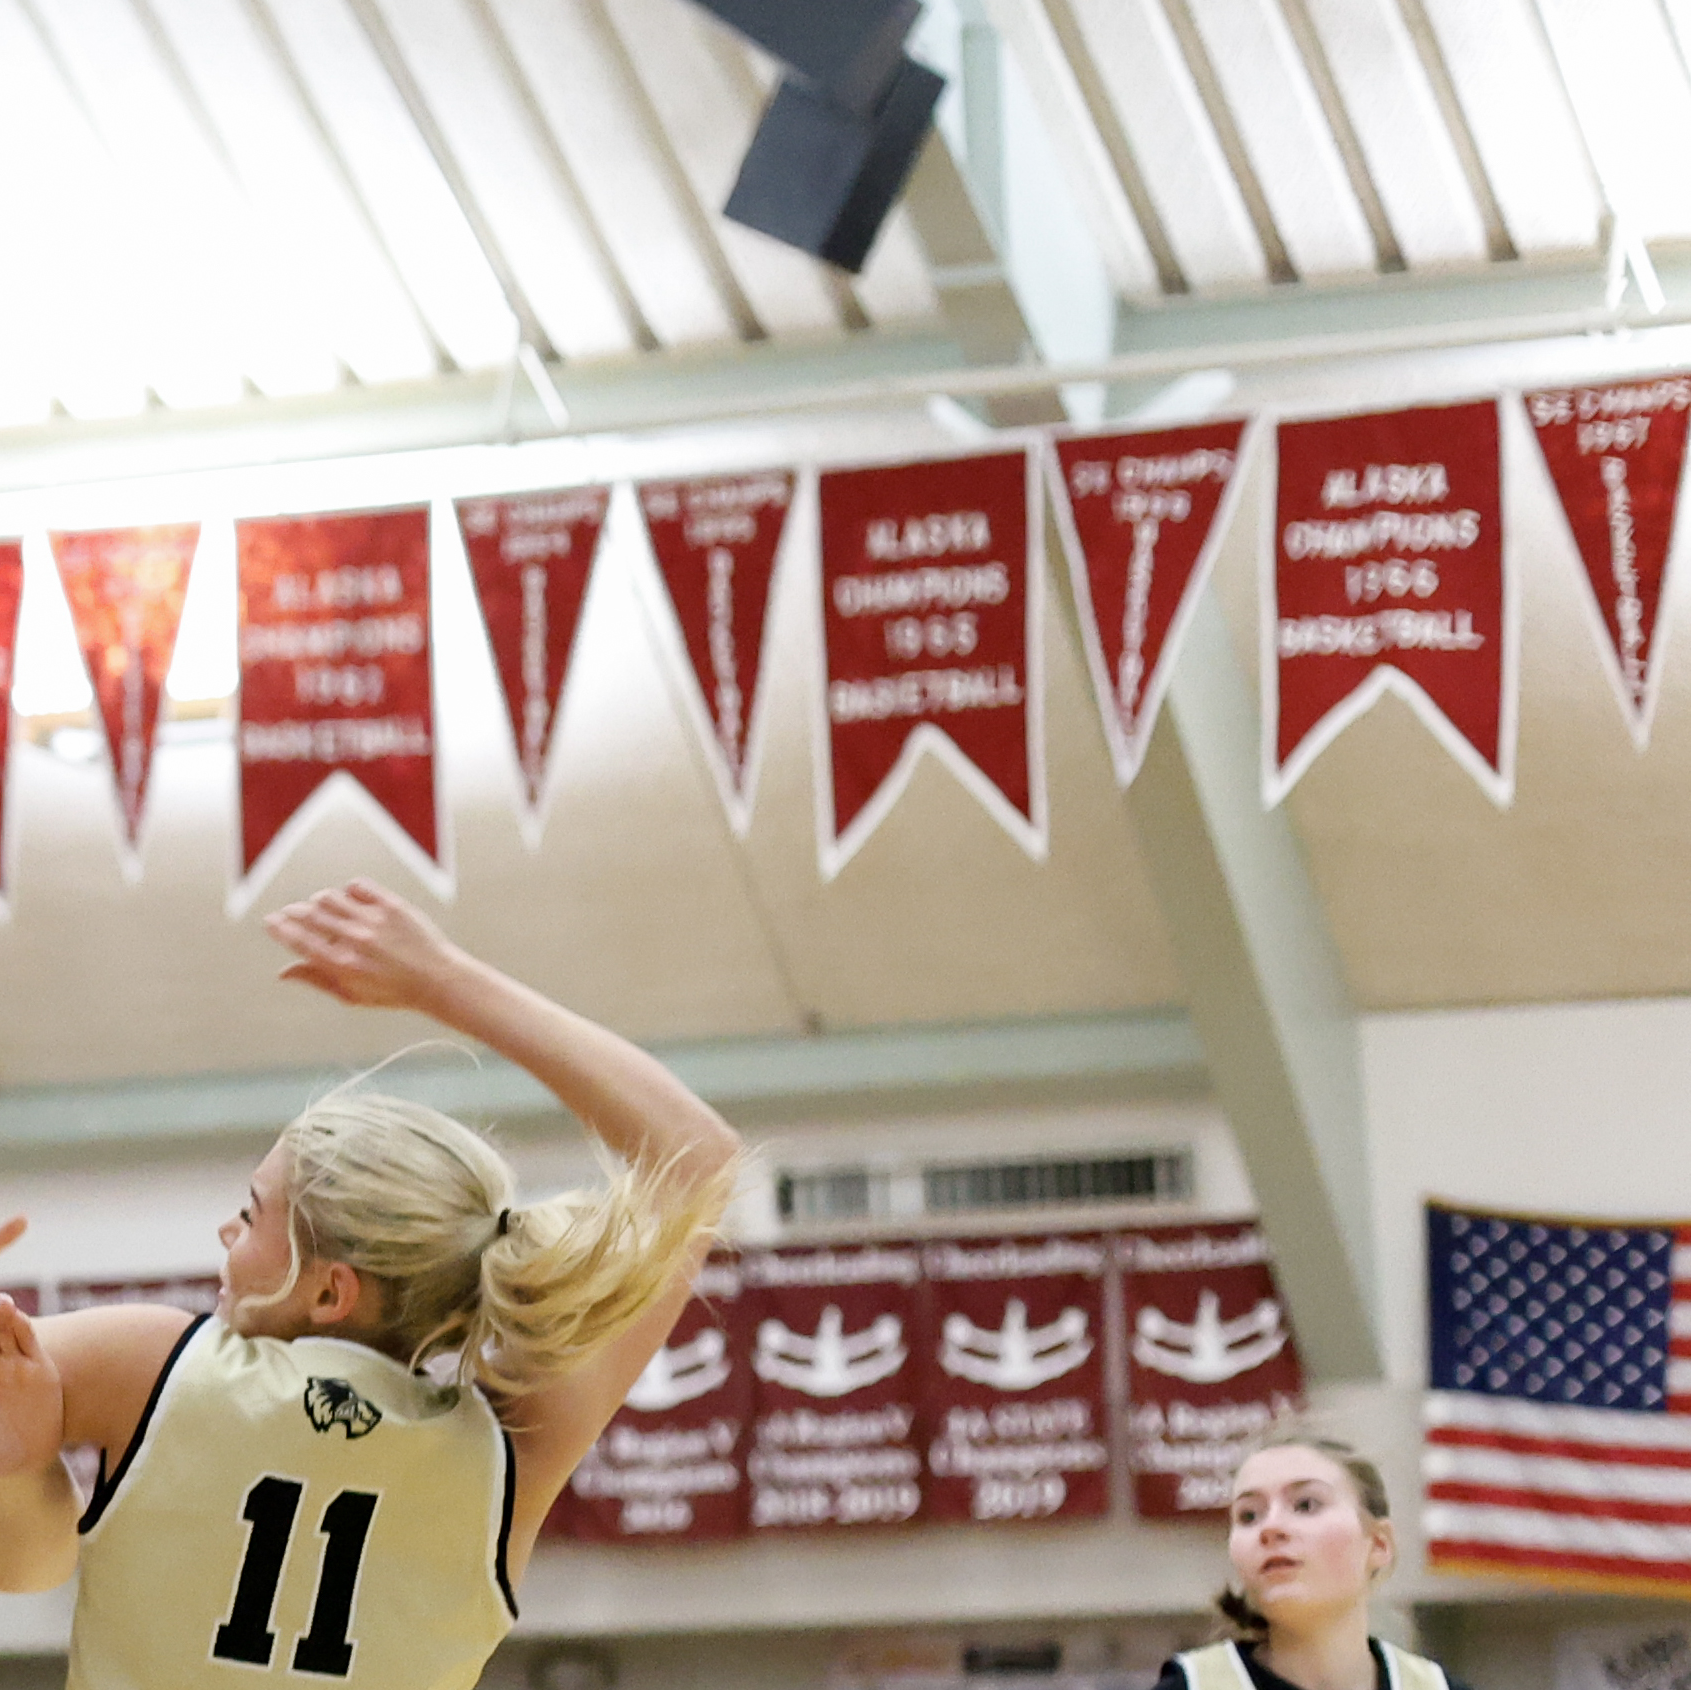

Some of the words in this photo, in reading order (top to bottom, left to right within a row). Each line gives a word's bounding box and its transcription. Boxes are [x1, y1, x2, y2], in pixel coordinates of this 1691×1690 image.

[1321, 463, 1450, 511] ALASKA
[865, 510, 992, 562] ALASKA
[1283, 508, 1482, 561] CHAMPIONS
[272, 565, 403, 611] ALASKA
[832, 560, 1009, 619] CHAMPIONS
[1344, 558, 1440, 606] 1966
[1278, 608, 1486, 660] BASKETBALL
[830, 663, 1024, 723] BASKETBALL
[210, 1471, 383, 1681] 11
